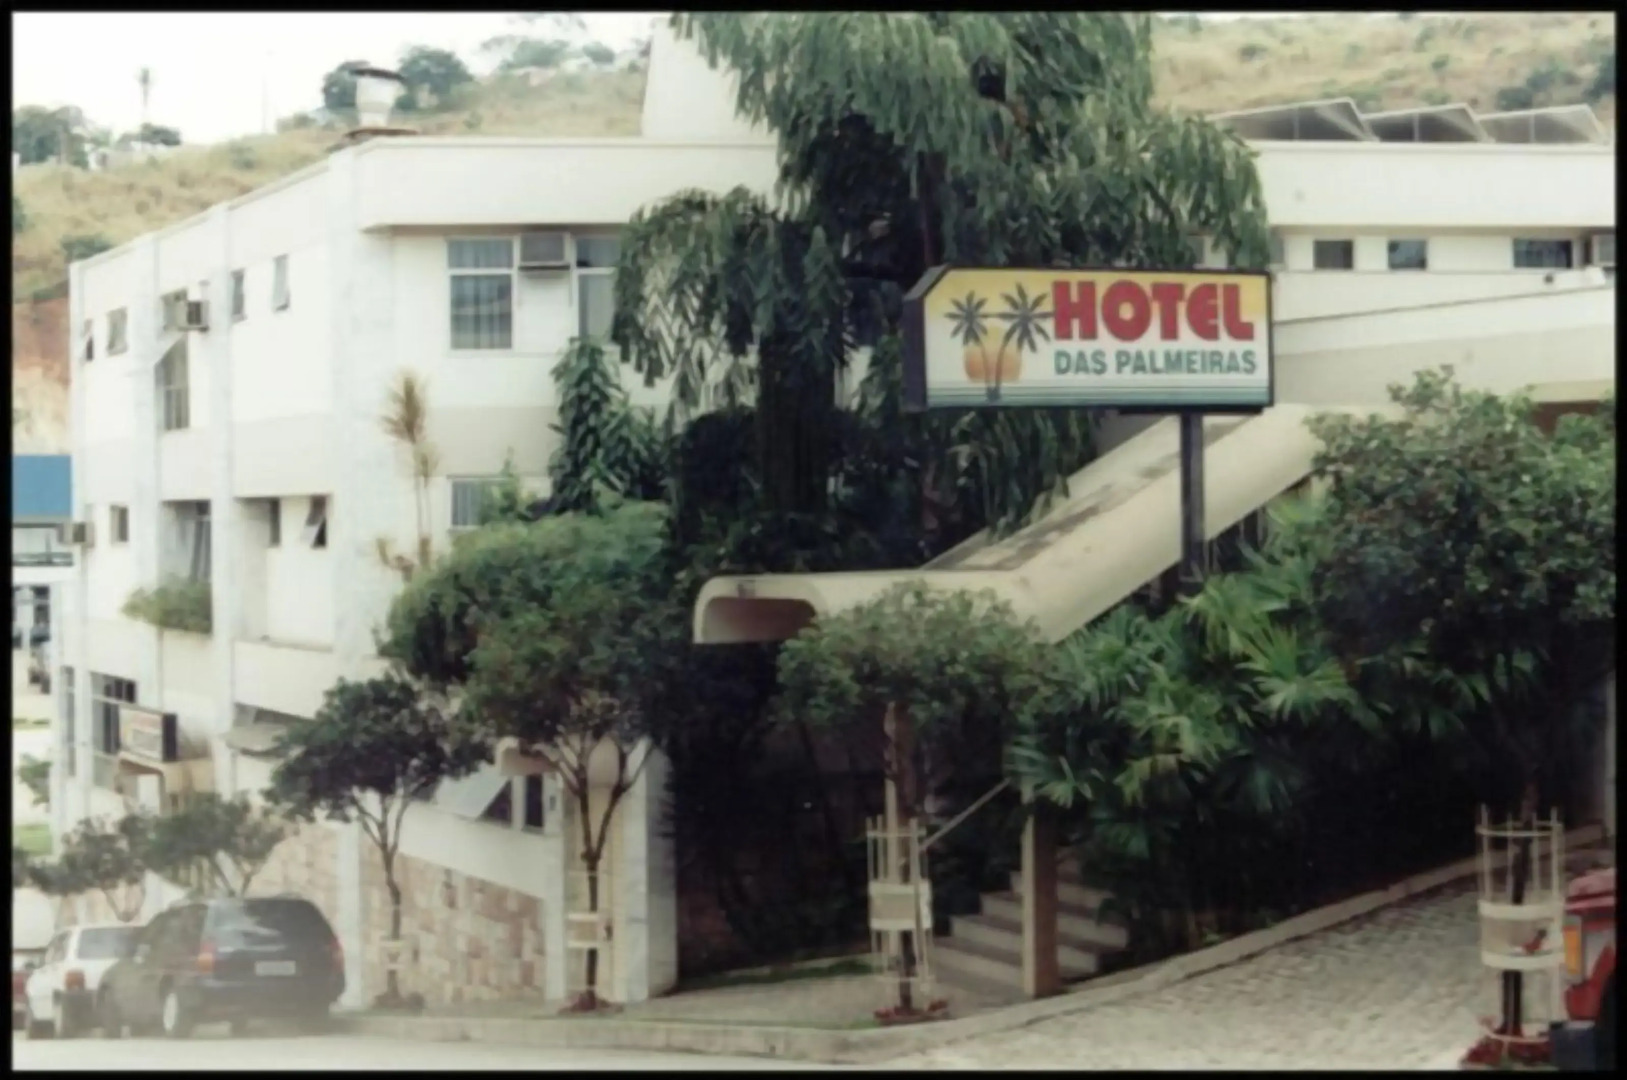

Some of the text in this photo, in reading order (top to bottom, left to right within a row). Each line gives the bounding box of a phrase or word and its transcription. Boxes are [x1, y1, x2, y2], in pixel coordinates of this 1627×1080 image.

[1052, 280, 1255, 342] HOTEL
[1054, 350, 1257, 375] DAS PALMEIRAS
